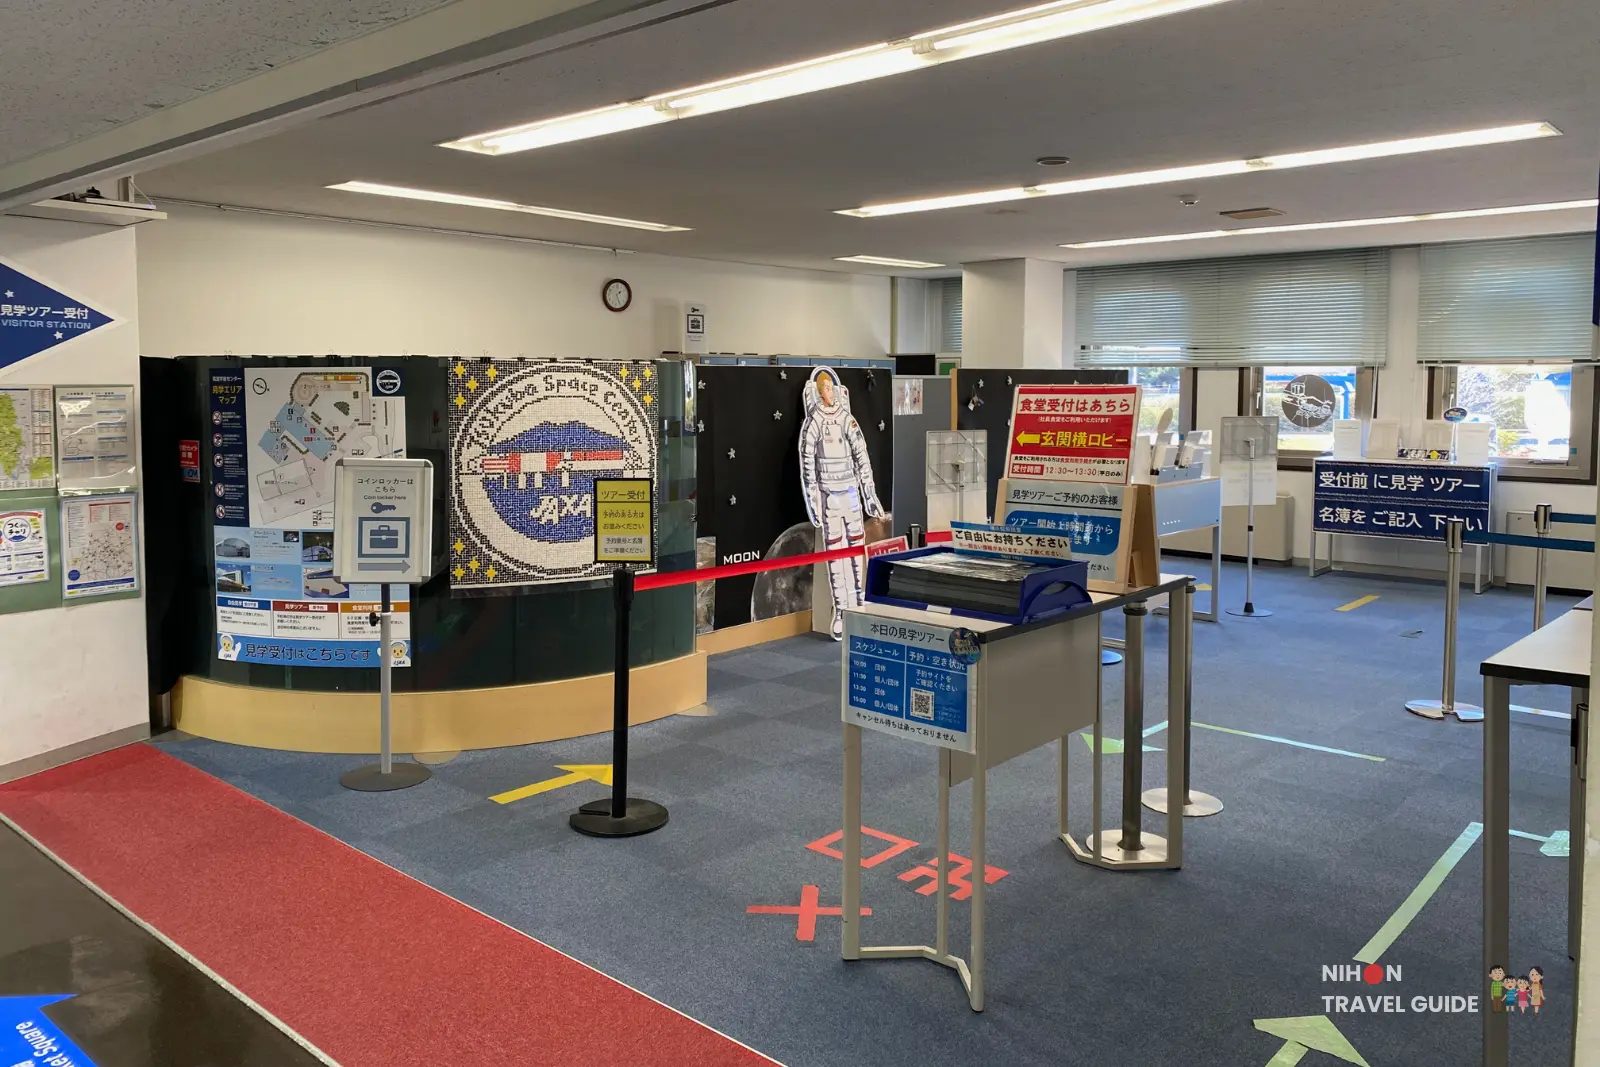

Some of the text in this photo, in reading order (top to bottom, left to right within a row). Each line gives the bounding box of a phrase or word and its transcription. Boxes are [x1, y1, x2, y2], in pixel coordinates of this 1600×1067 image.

[0, 304, 89, 320] 見学ツアー受付
[1, 319, 91, 330] VISITOR STATION
[212, 385, 243, 394] 見学エリア
[218, 396, 237, 404] マップ
[1020, 397, 1131, 413] 食堂受付はあちら
[543, 374, 599, 397] Space
[603, 391, 643, 445] Center
[1040, 431, 1128, 448] 玄関横ロビー
[1012, 464, 1041, 474] 受付時間
[1319, 471, 1481, 492] 受付前 に見学 ツアー
[601, 490, 646, 500] ツアー受付
[1012, 489, 1119, 506] 見学ツアーご予約のお客様
[603, 509, 645, 519] 予約のある方は
[1318, 506, 1367, 524] 名簿を
[1372, 510, 1423, 529] ご記入
[955, 530, 1068, 549] ご自由にお持ちください
[723, 550, 760, 566] MOON
[870, 623, 945, 643] 本日の見学ツアー
[245, 643, 371, 662] 見学受付はこちらです
[855, 641, 900, 657] スケジュール
[853, 659, 867, 668] 10:00
[915, 669, 952, 683] 予約サイトを
[915, 679, 958, 692] ご確認ください
[856, 711, 957, 743] キャンセル待ちは承っておりません
[15, 1020, 58, 1058] Square
